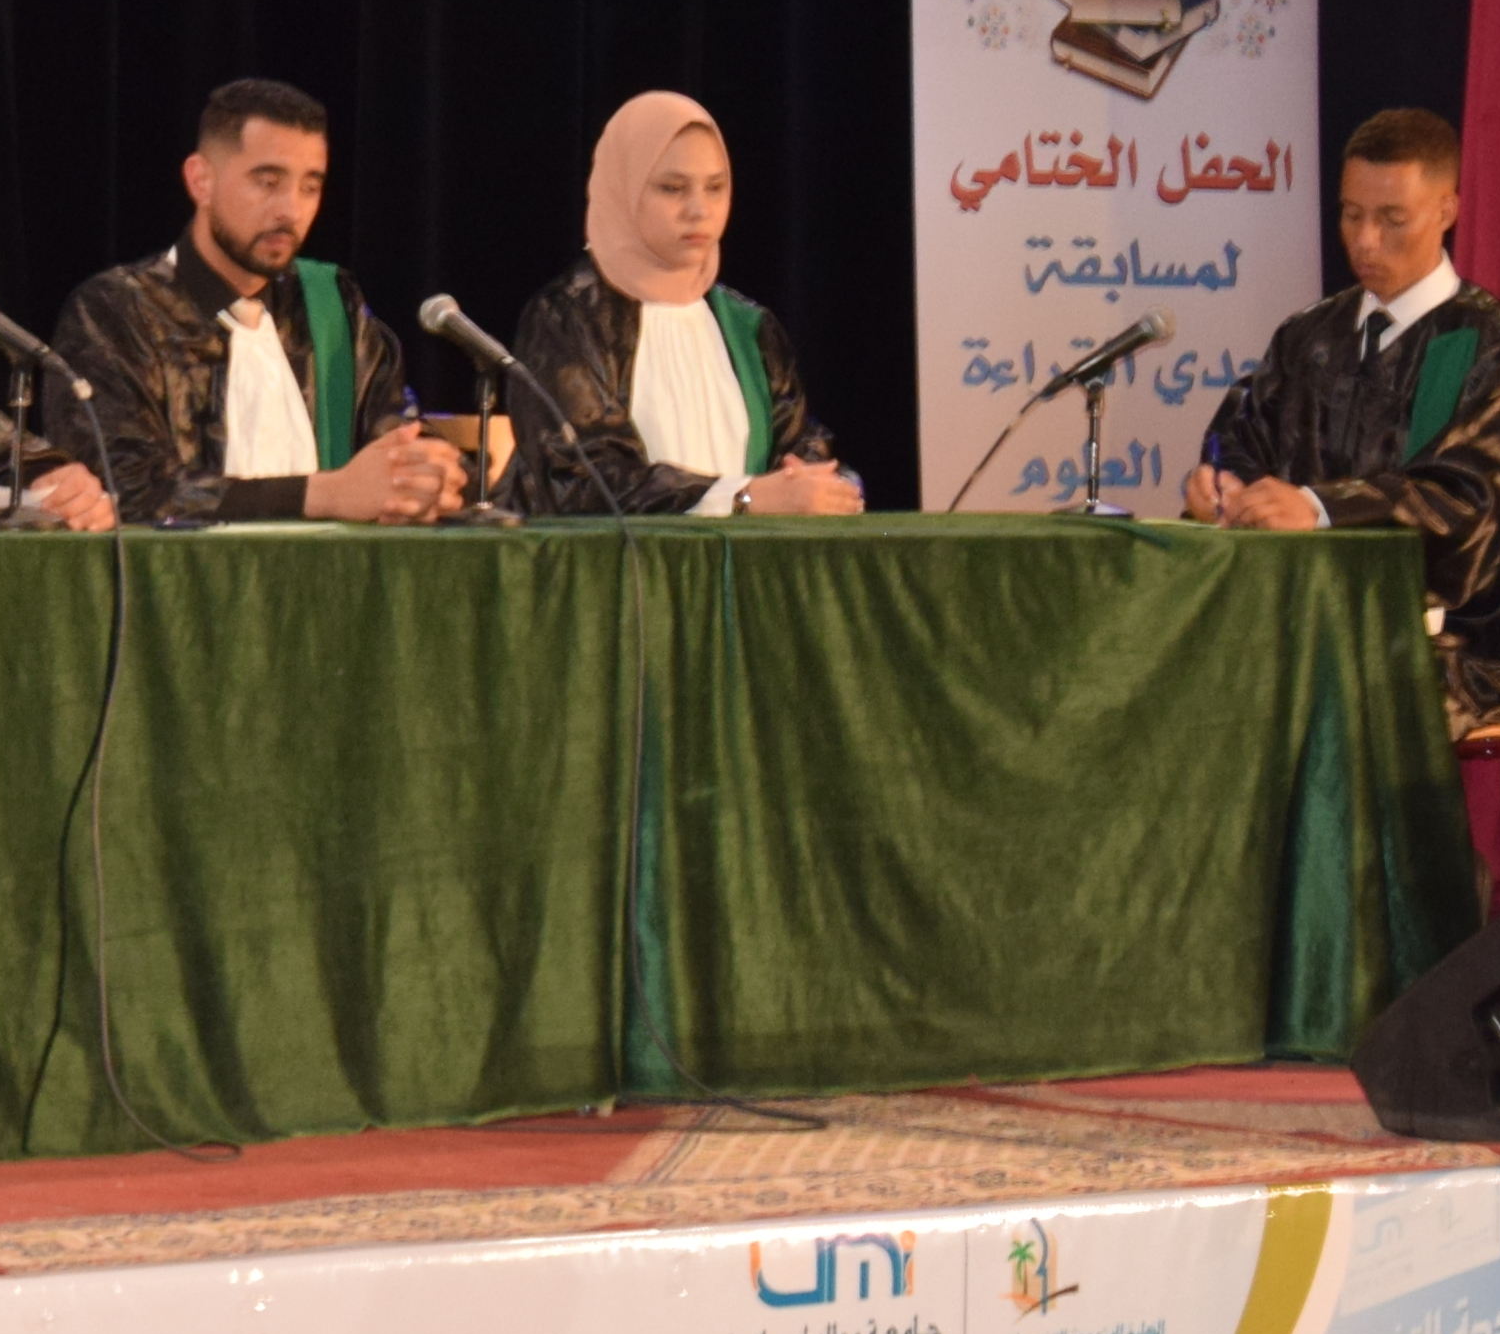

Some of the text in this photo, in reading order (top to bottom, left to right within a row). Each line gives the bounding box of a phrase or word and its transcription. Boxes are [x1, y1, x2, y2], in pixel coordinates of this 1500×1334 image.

[949, 128, 1293, 213] الحفل الختامي
[1024, 235, 1242, 303] لمسابقة
